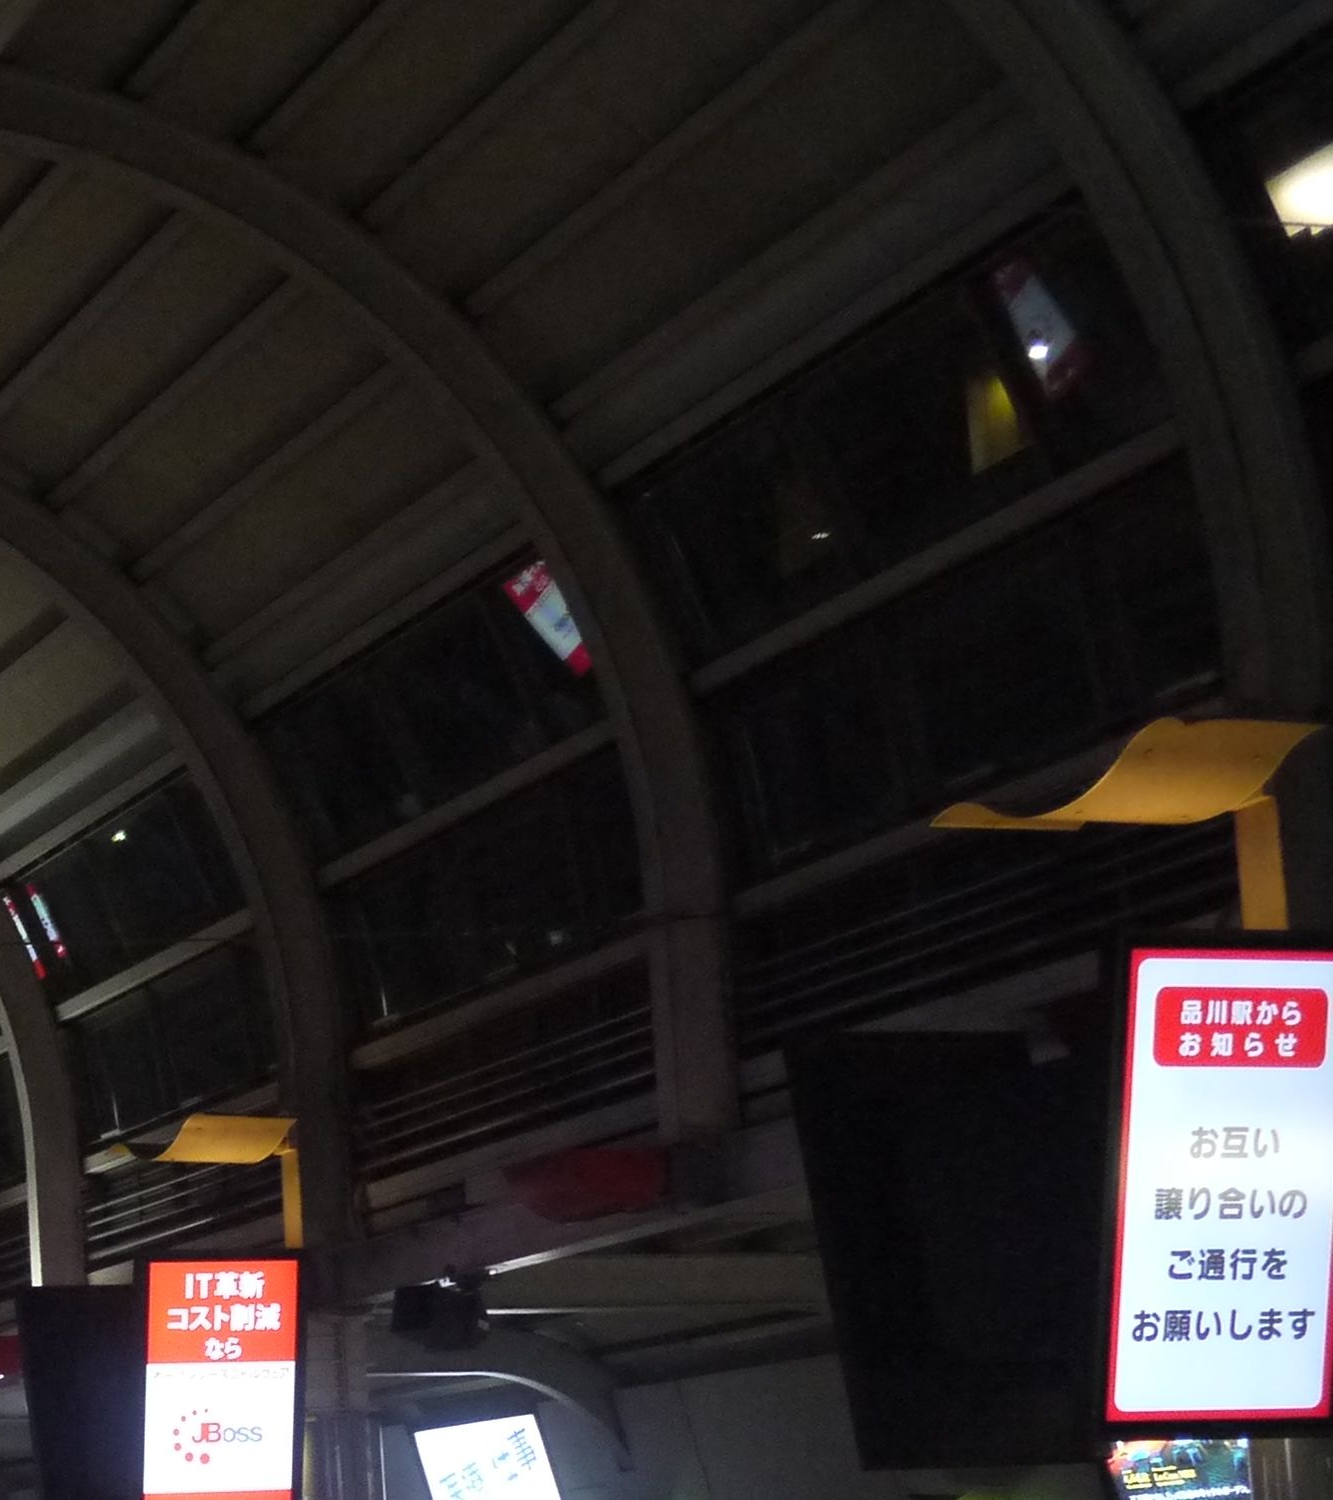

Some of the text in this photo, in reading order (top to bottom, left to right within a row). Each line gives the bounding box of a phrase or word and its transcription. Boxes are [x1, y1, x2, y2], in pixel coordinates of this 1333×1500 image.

[1180, 1000, 1302, 1025] 品川駅から
[1178, 1032, 1298, 1057] お知らせ
[1190, 1126, 1281, 1158] お互い
[1153, 1187, 1308, 1220] 譲り合いの
[1168, 1248, 1288, 1281] ご通行を
[184, 1271, 265, 1299] IT革新
[166, 1303, 281, 1331] コスト削減
[1132, 1308, 1316, 1342] お願いします
[204, 1337, 242, 1360] なら
[192, 1422, 262, 1443] JBoss
